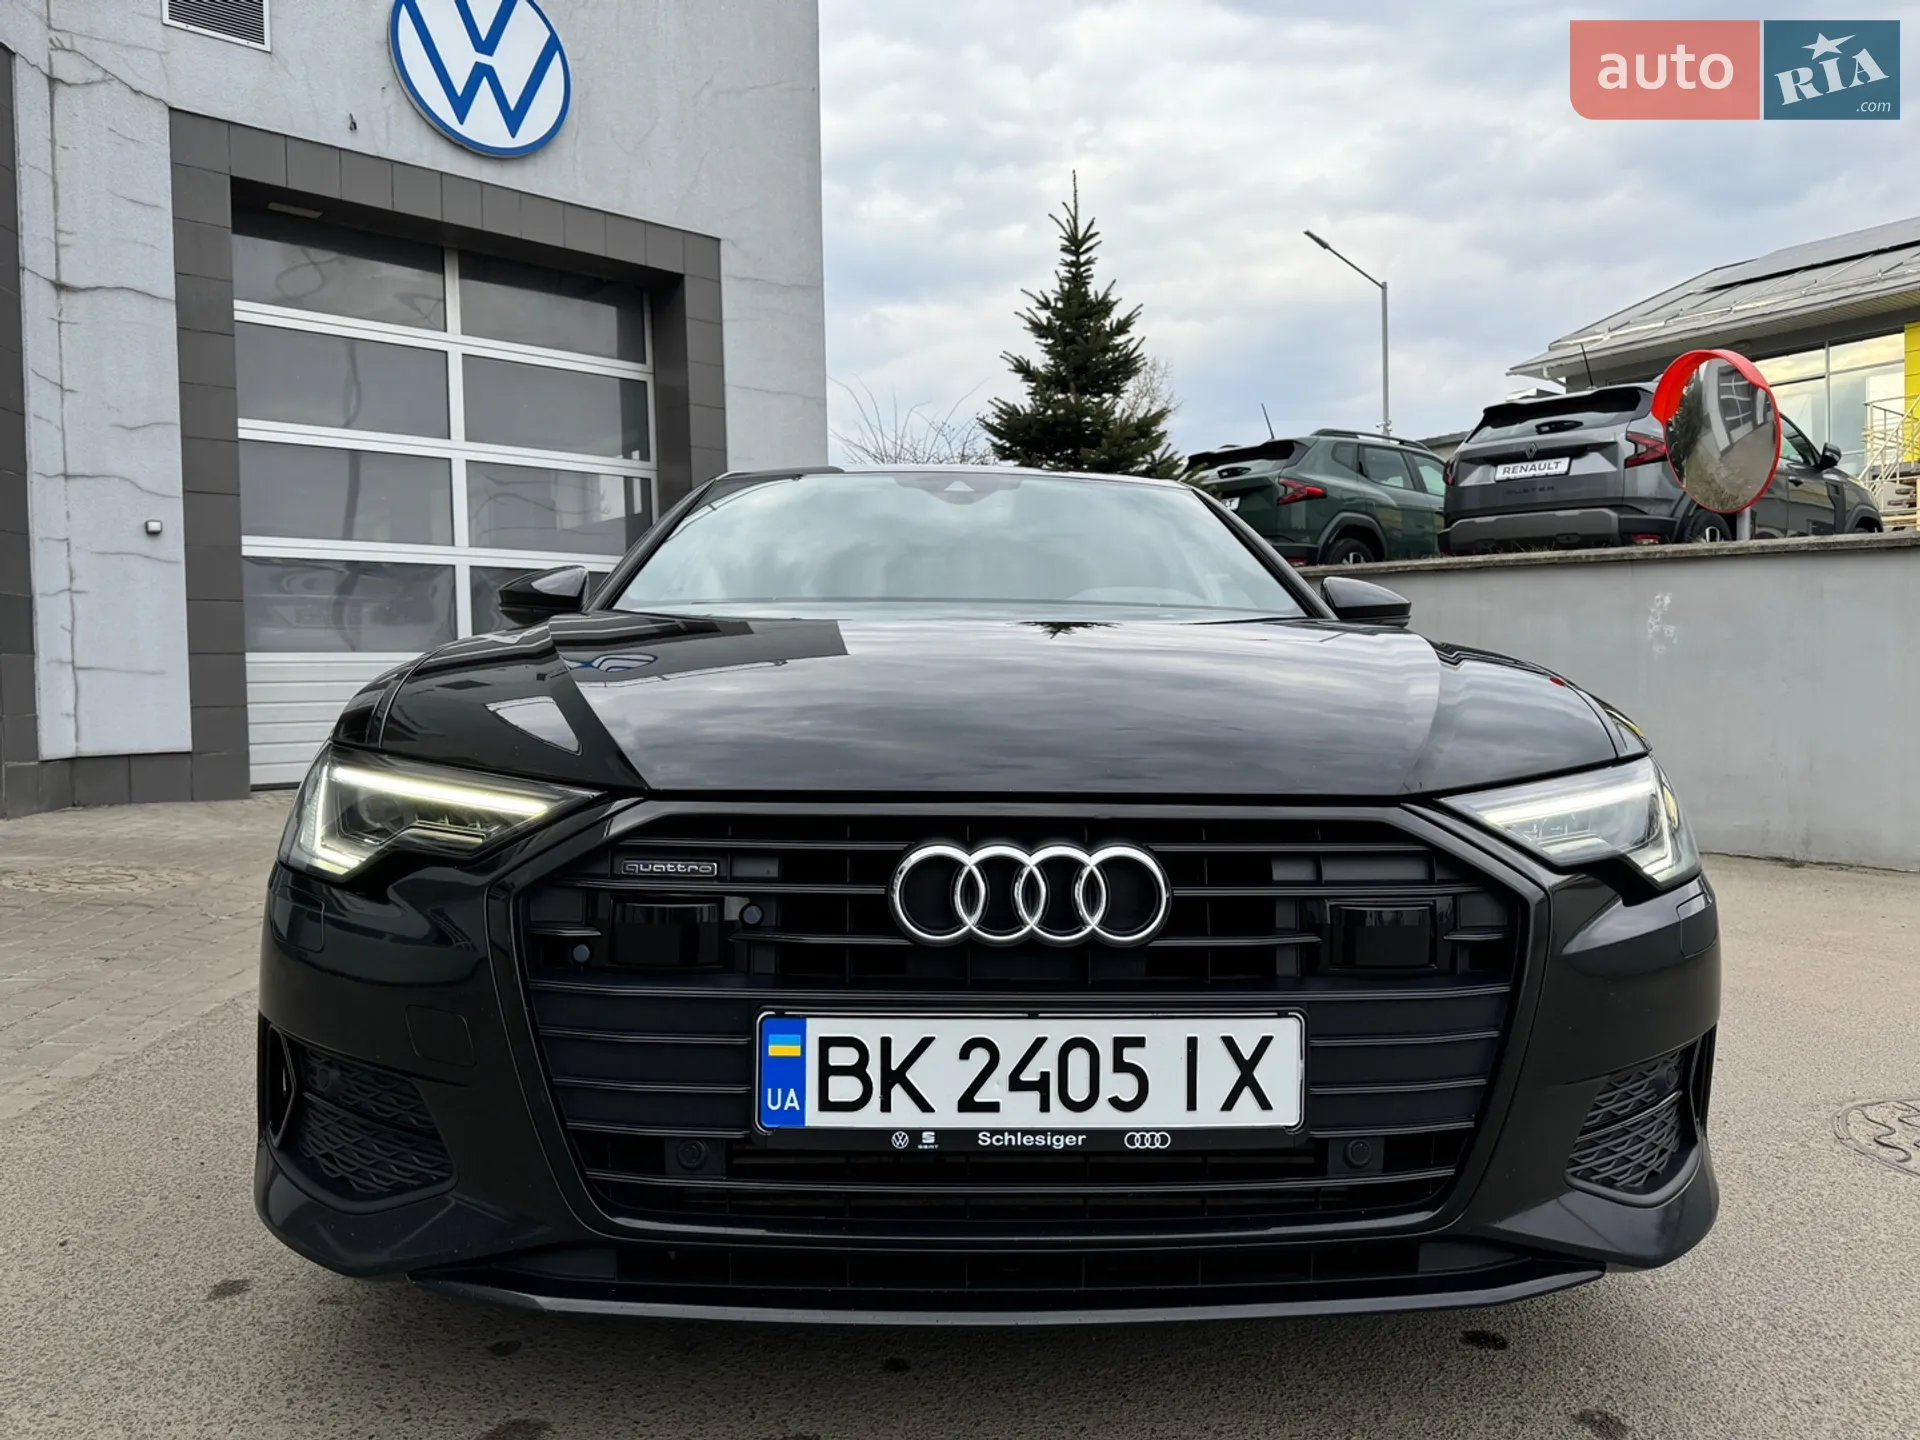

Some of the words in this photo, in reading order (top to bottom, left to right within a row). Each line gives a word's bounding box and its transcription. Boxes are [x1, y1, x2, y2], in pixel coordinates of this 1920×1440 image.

[1502, 461, 1561, 475] RENAULT
[625, 863, 713, 874] quattro
[817, 1035, 936, 1113] BK
[957, 1036, 1150, 1113] 2405
[1185, 1035, 1275, 1112] IX
[767, 1087, 800, 1111] UA
[978, 1131, 1087, 1149] Schlesiger
